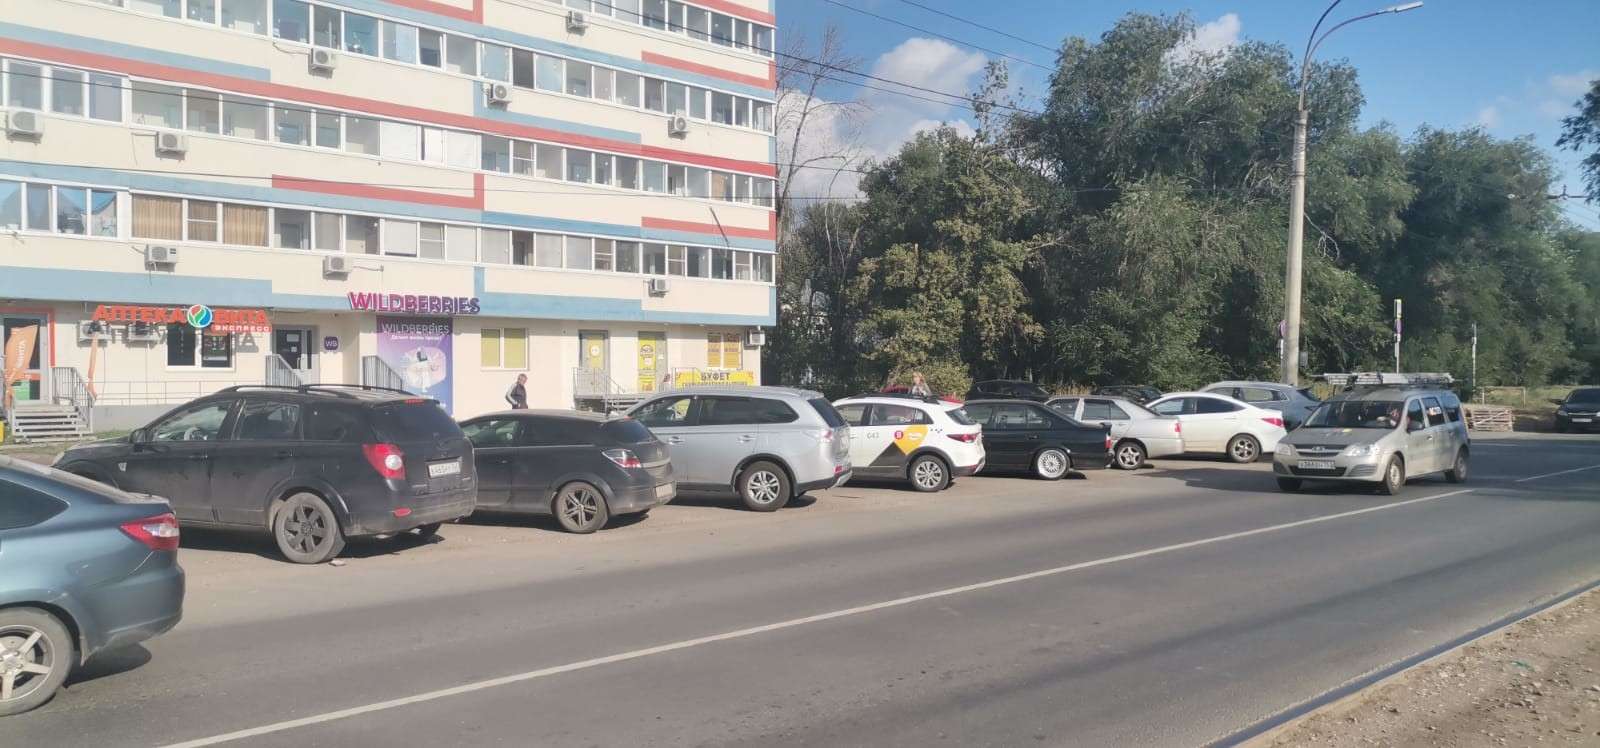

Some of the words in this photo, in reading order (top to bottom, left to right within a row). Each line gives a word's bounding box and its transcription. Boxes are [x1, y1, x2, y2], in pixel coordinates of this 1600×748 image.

[347, 292, 480, 314] WILDBERRIES
[93, 304, 187, 324] АПТЕКА
[214, 308, 270, 324] ВИТА
[382, 324, 449, 336] WILDBERRIES
[701, 372, 730, 380] БУФЕТ
